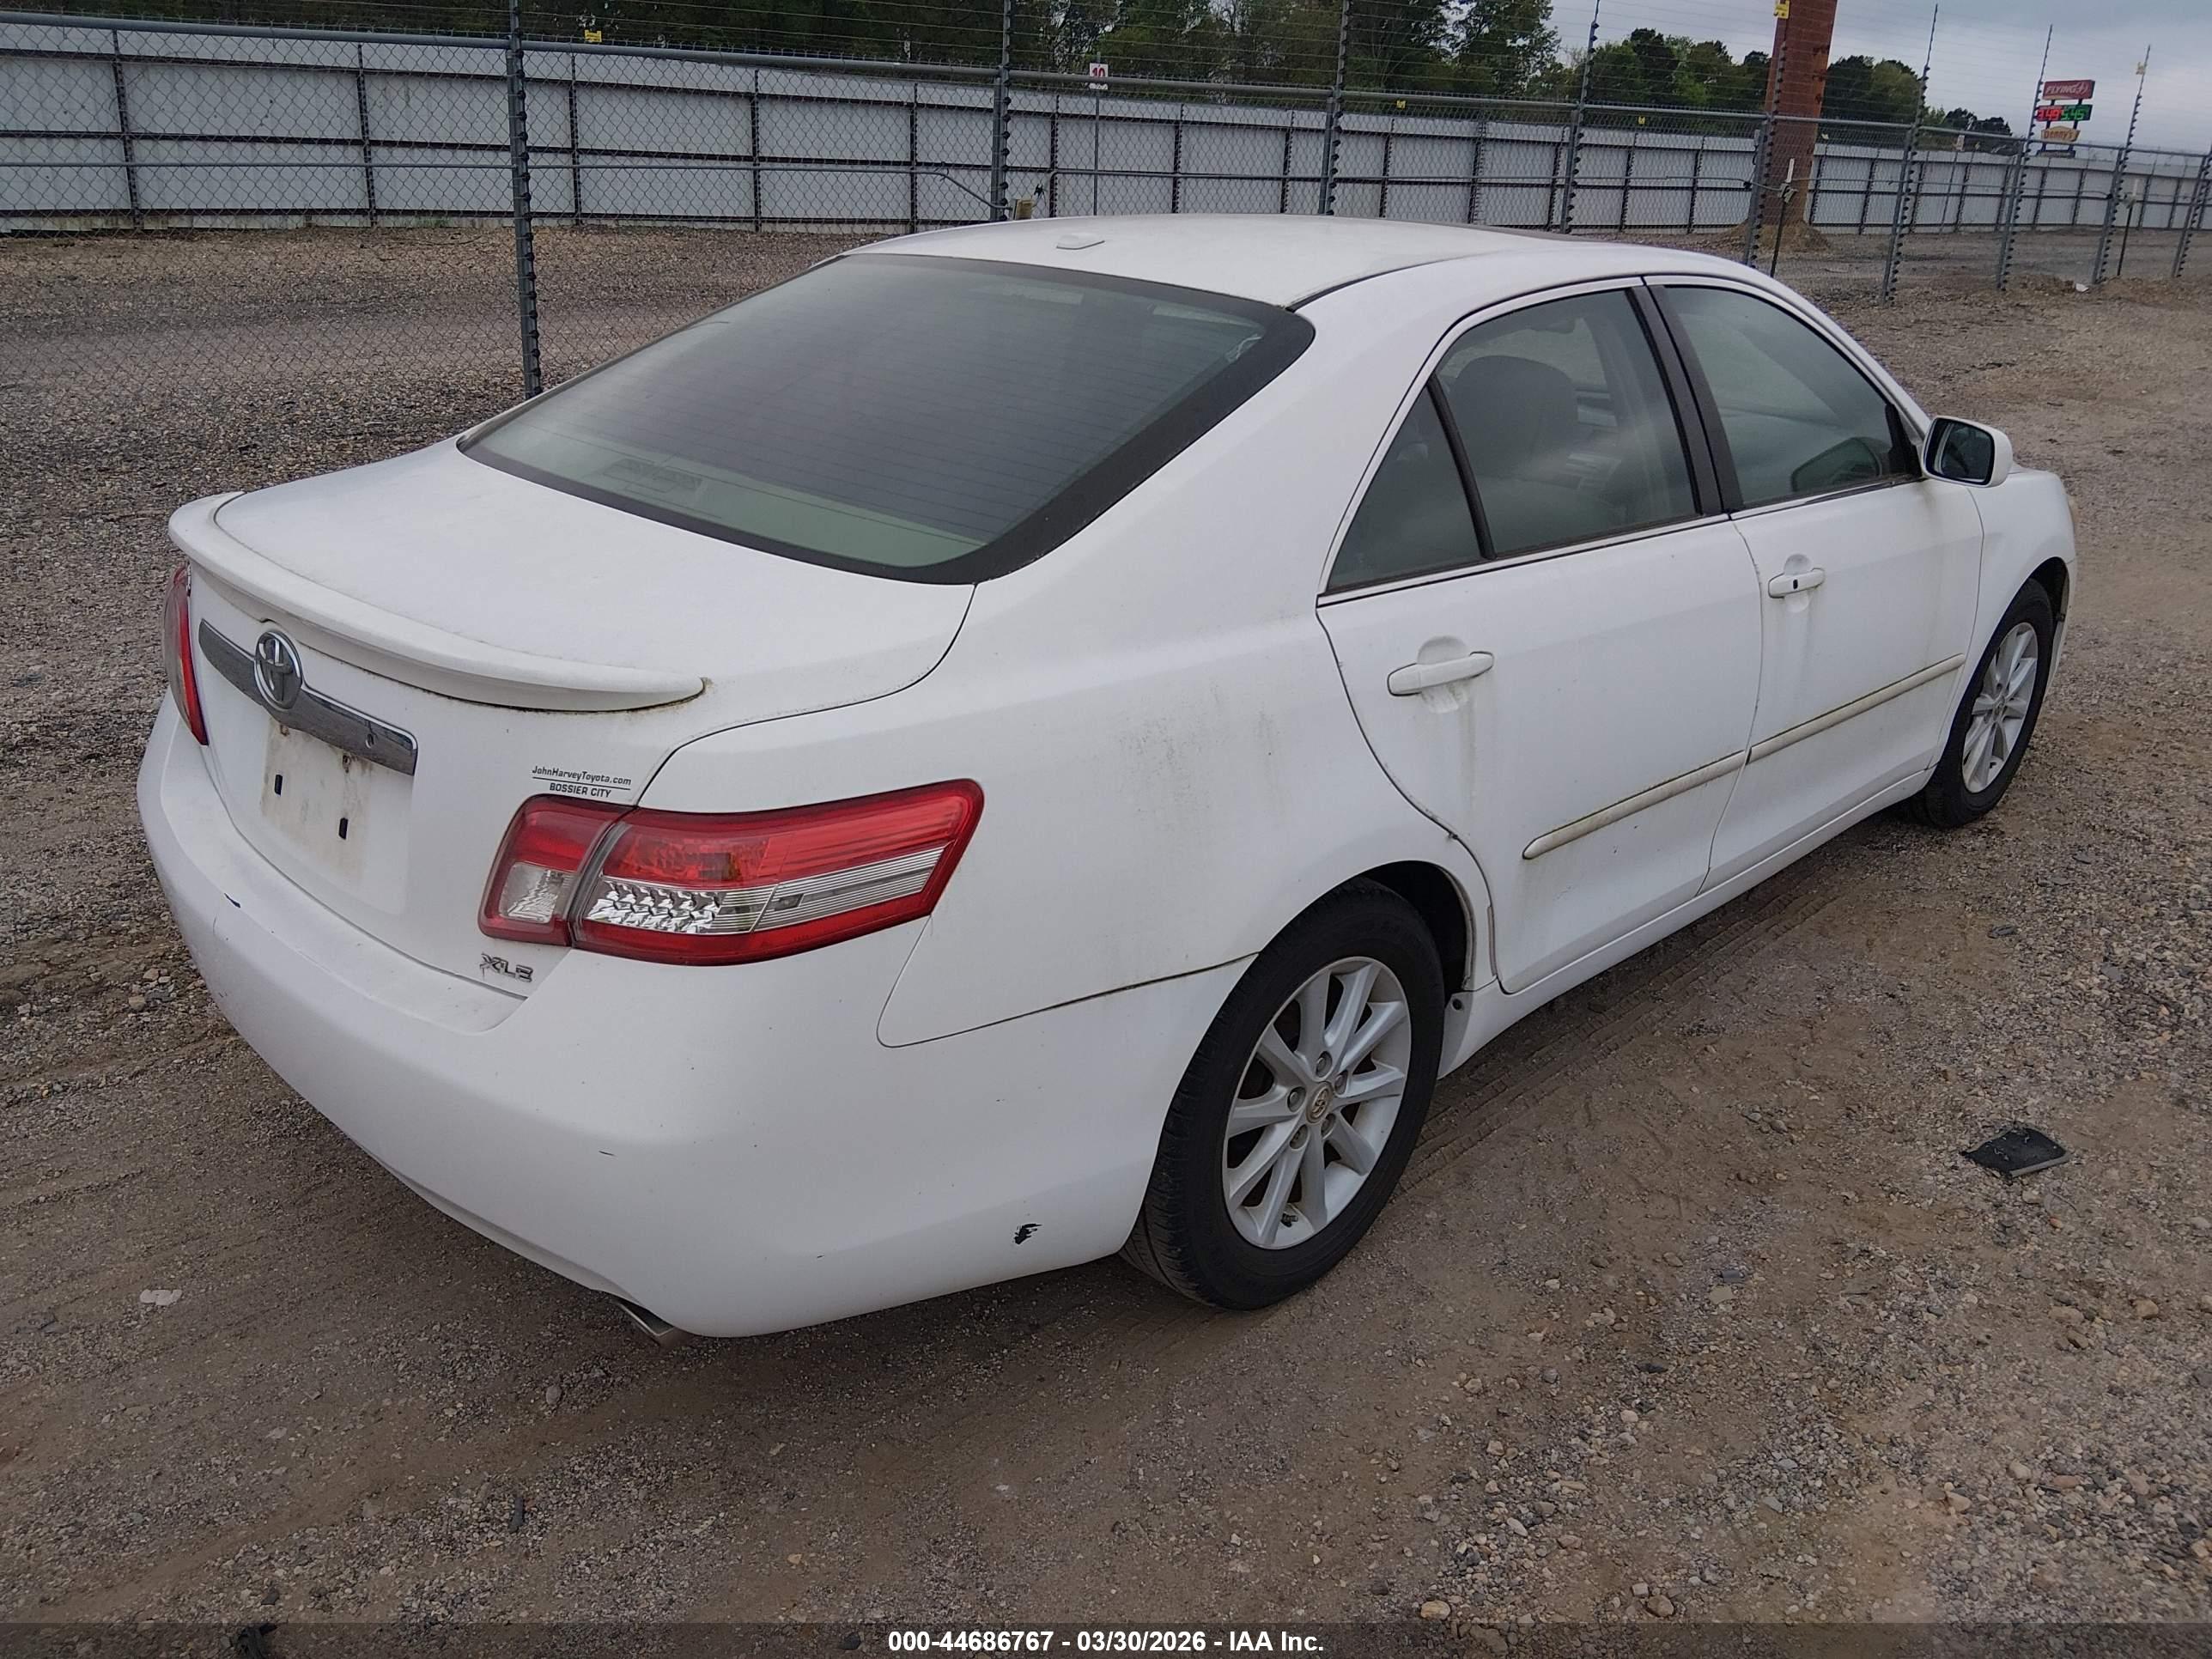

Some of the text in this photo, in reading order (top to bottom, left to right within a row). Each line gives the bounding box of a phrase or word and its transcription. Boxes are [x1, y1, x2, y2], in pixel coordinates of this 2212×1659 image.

[2045, 84, 2075, 94] FLYING
[2044, 130, 2074, 141] Denny's
[532, 766, 632, 786] JohnHarveyToyota.com
[550, 782, 611, 798] BOSSIER CITY
[479, 953, 534, 982] XLE
